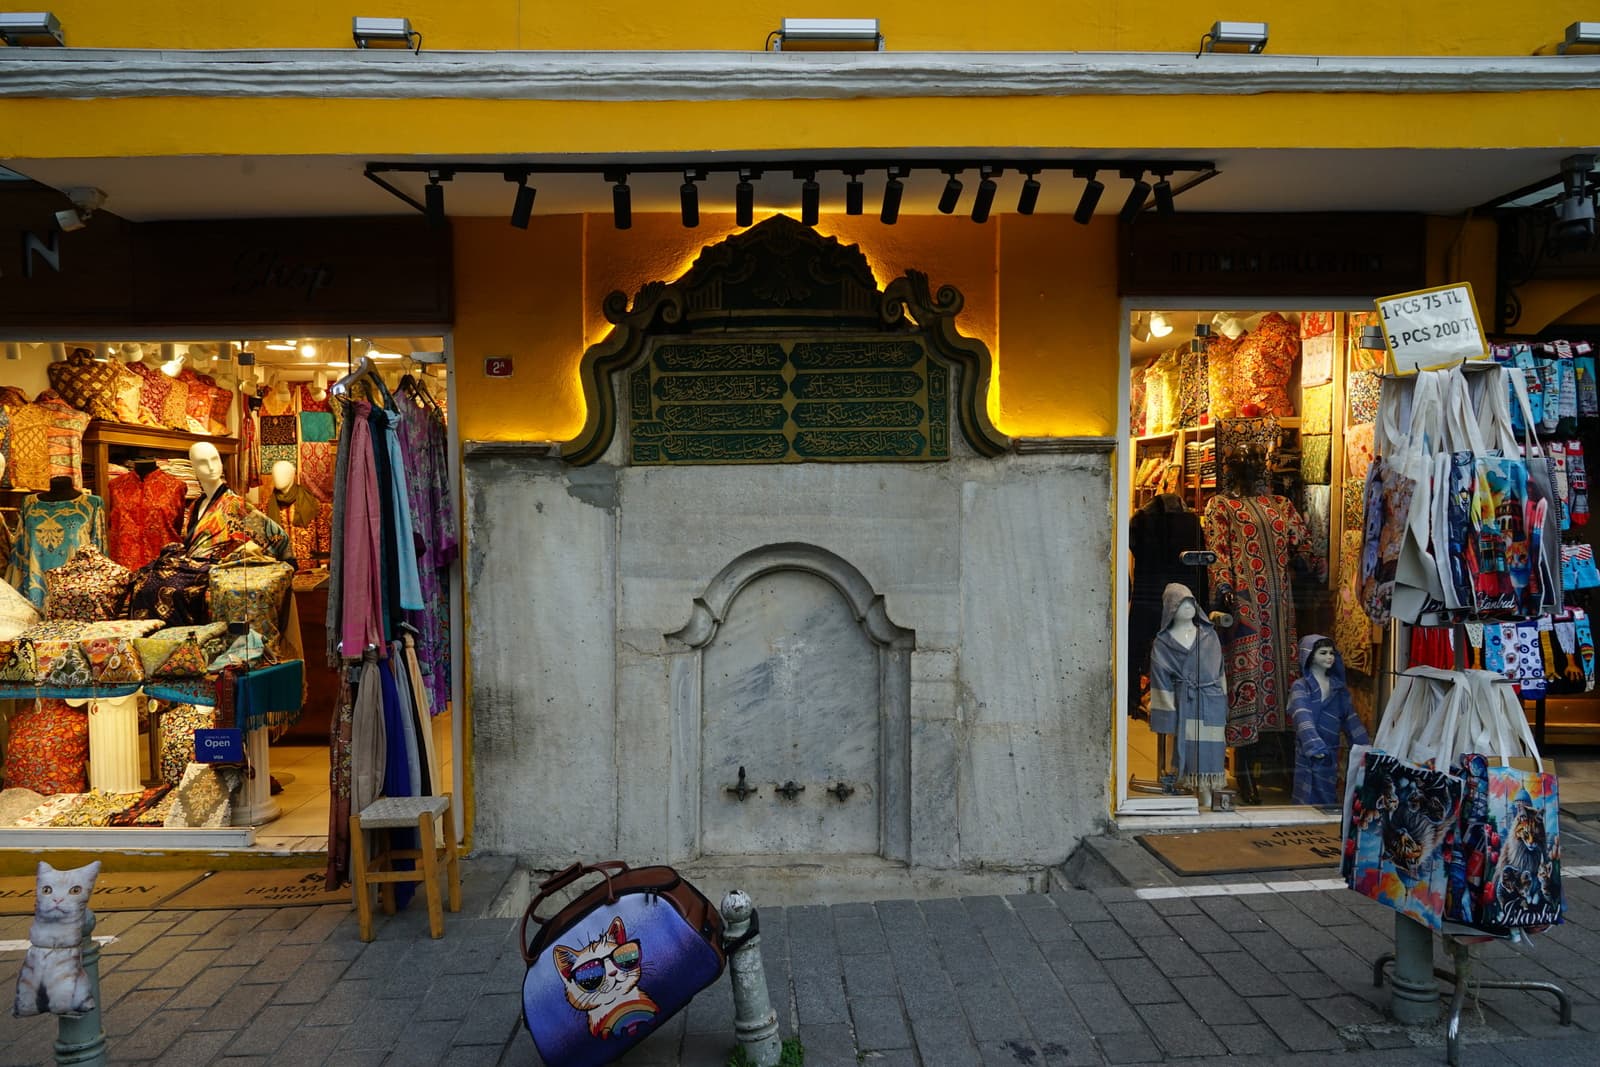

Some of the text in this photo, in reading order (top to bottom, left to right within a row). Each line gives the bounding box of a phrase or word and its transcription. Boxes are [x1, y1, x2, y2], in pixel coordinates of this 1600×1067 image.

[1381, 290, 1462, 320] 1 PCS 75 TL
[1389, 317, 1478, 349] 3 PCS 200 TL
[204, 739, 231, 749] Open
[1251, 835, 1342, 849] ARMAN
